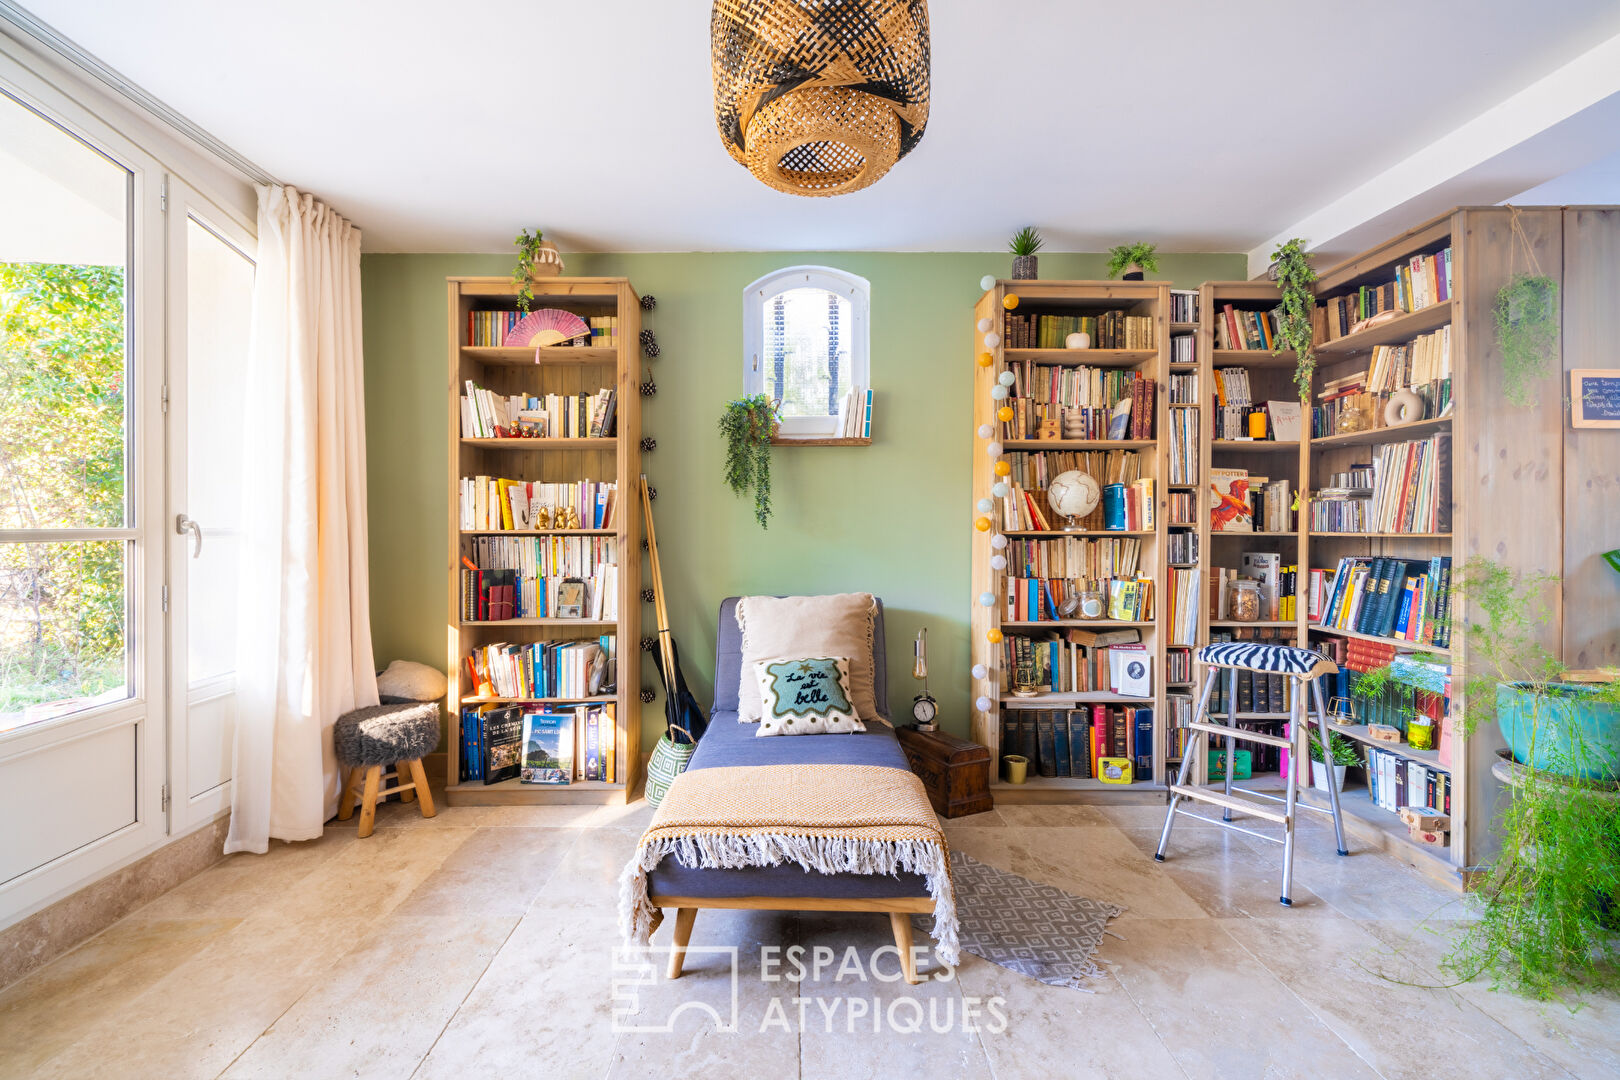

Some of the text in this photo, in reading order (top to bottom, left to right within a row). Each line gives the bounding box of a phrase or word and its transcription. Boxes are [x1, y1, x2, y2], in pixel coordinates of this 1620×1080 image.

[785, 670, 828, 683] La vie
[800, 680, 819, 690] est
[794, 689, 829, 705] belle
